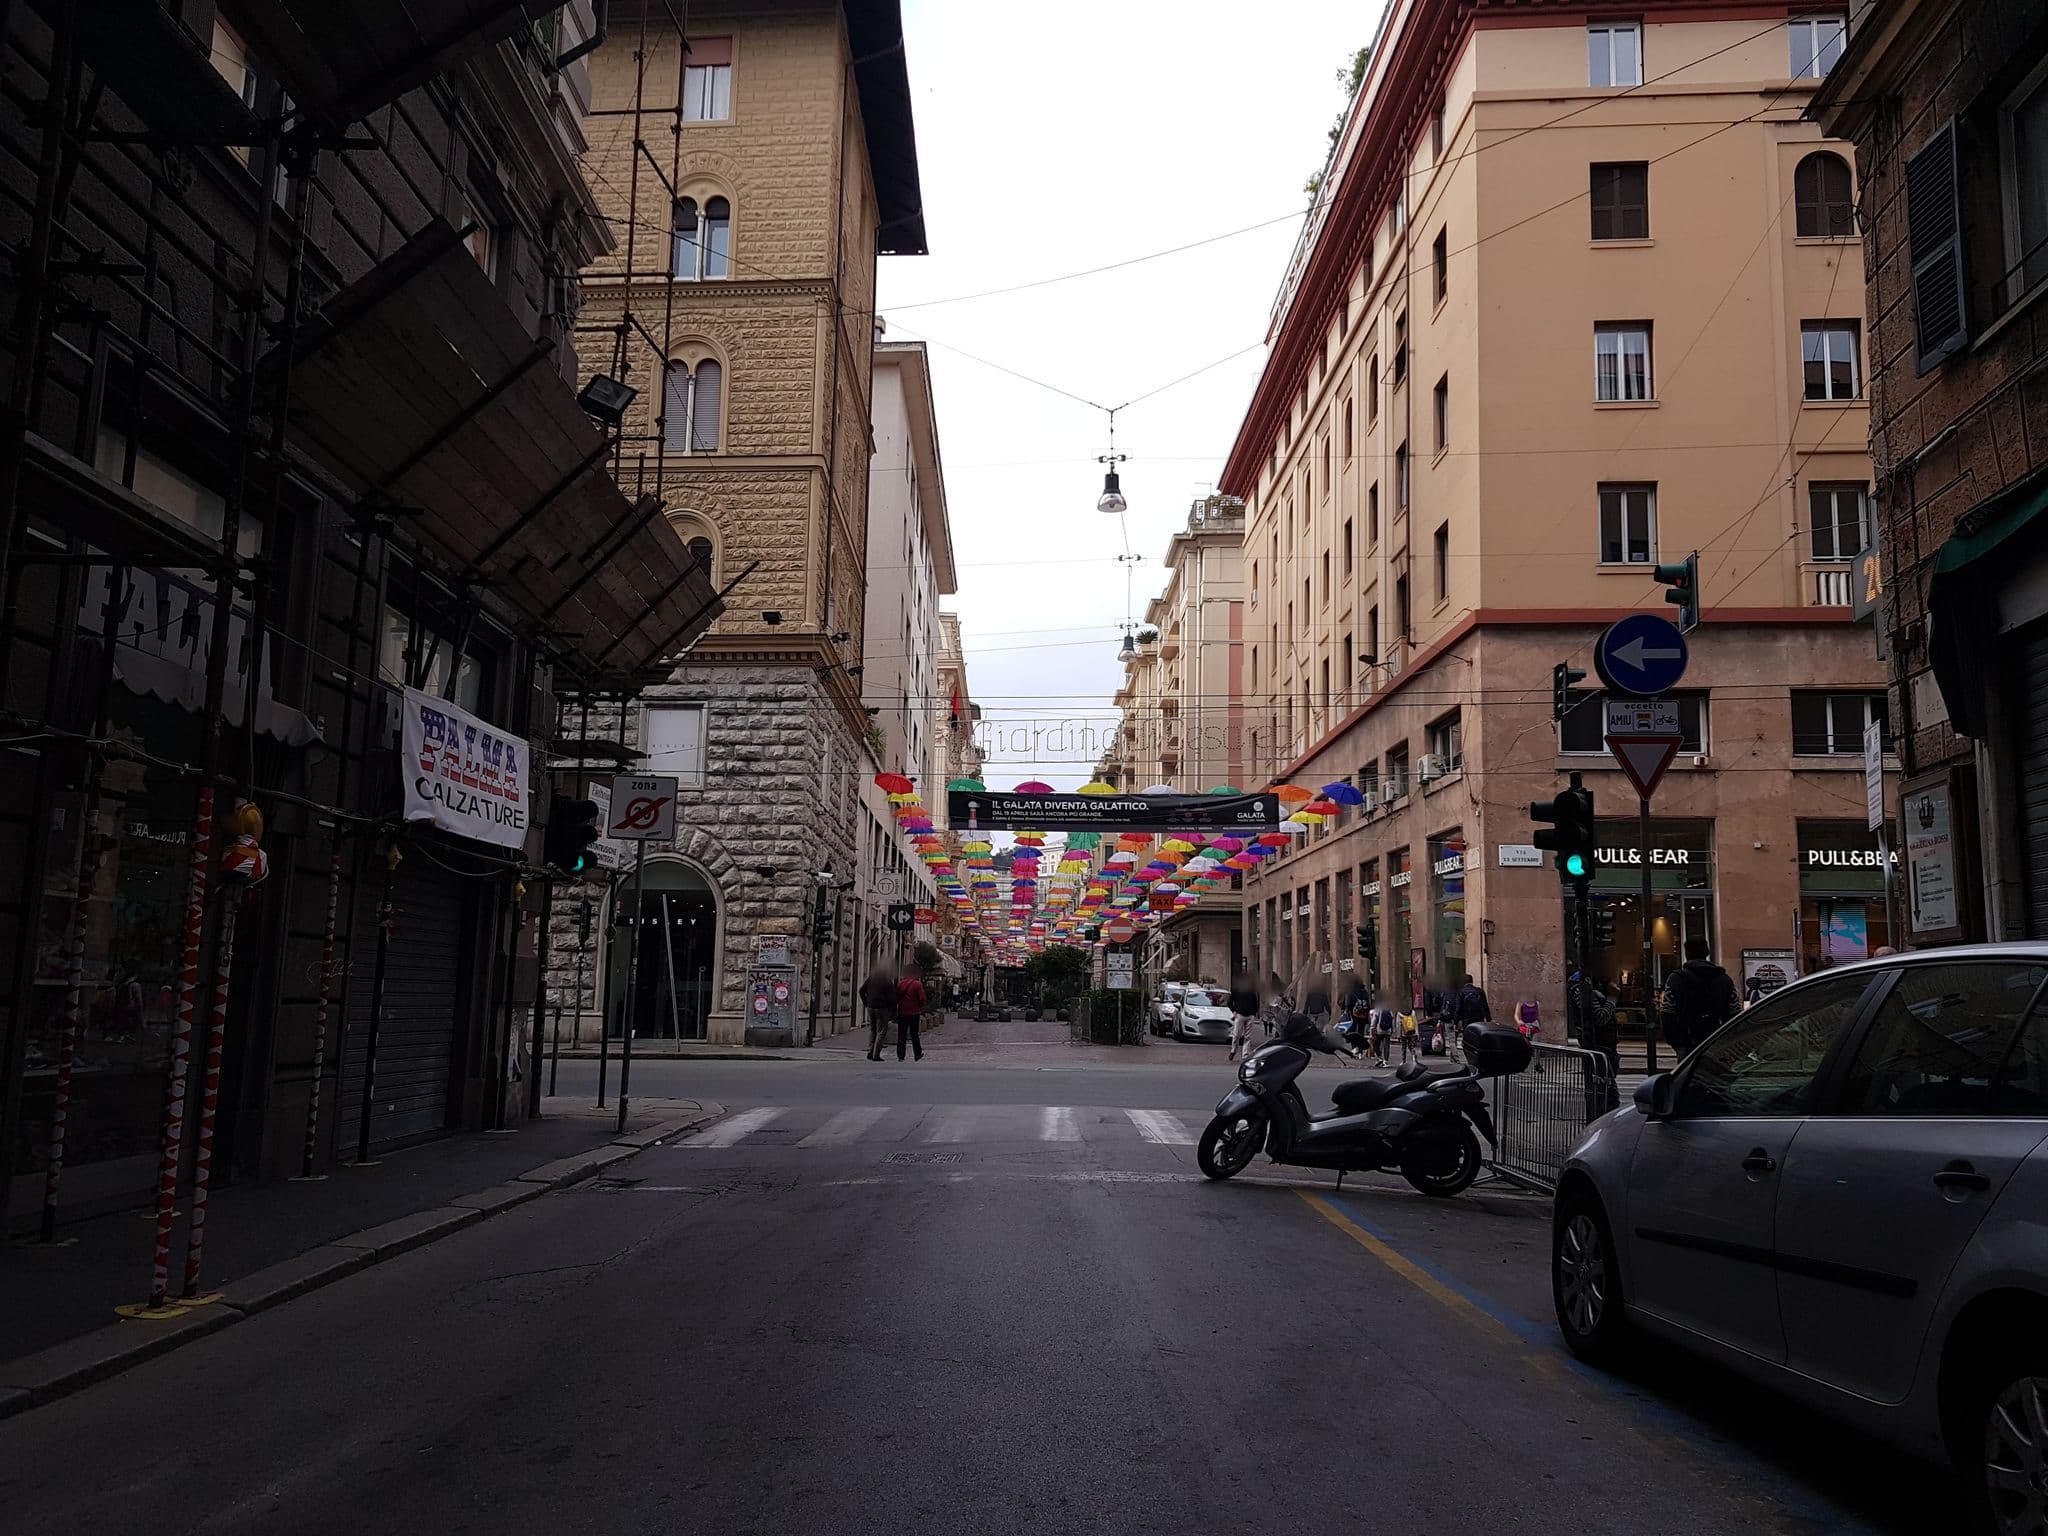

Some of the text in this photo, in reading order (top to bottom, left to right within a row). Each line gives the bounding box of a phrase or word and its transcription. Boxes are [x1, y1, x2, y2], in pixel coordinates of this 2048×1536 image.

[1611, 714, 1632, 726] AMIU
[419, 705, 520, 803] PALMA
[631, 780, 657, 791] zona
[415, 776, 525, 830] CALZATURE
[992, 800, 1149, 811] IL GALATA DIVENTA GALATTICO.
[628, 917, 697, 926] SISEY
